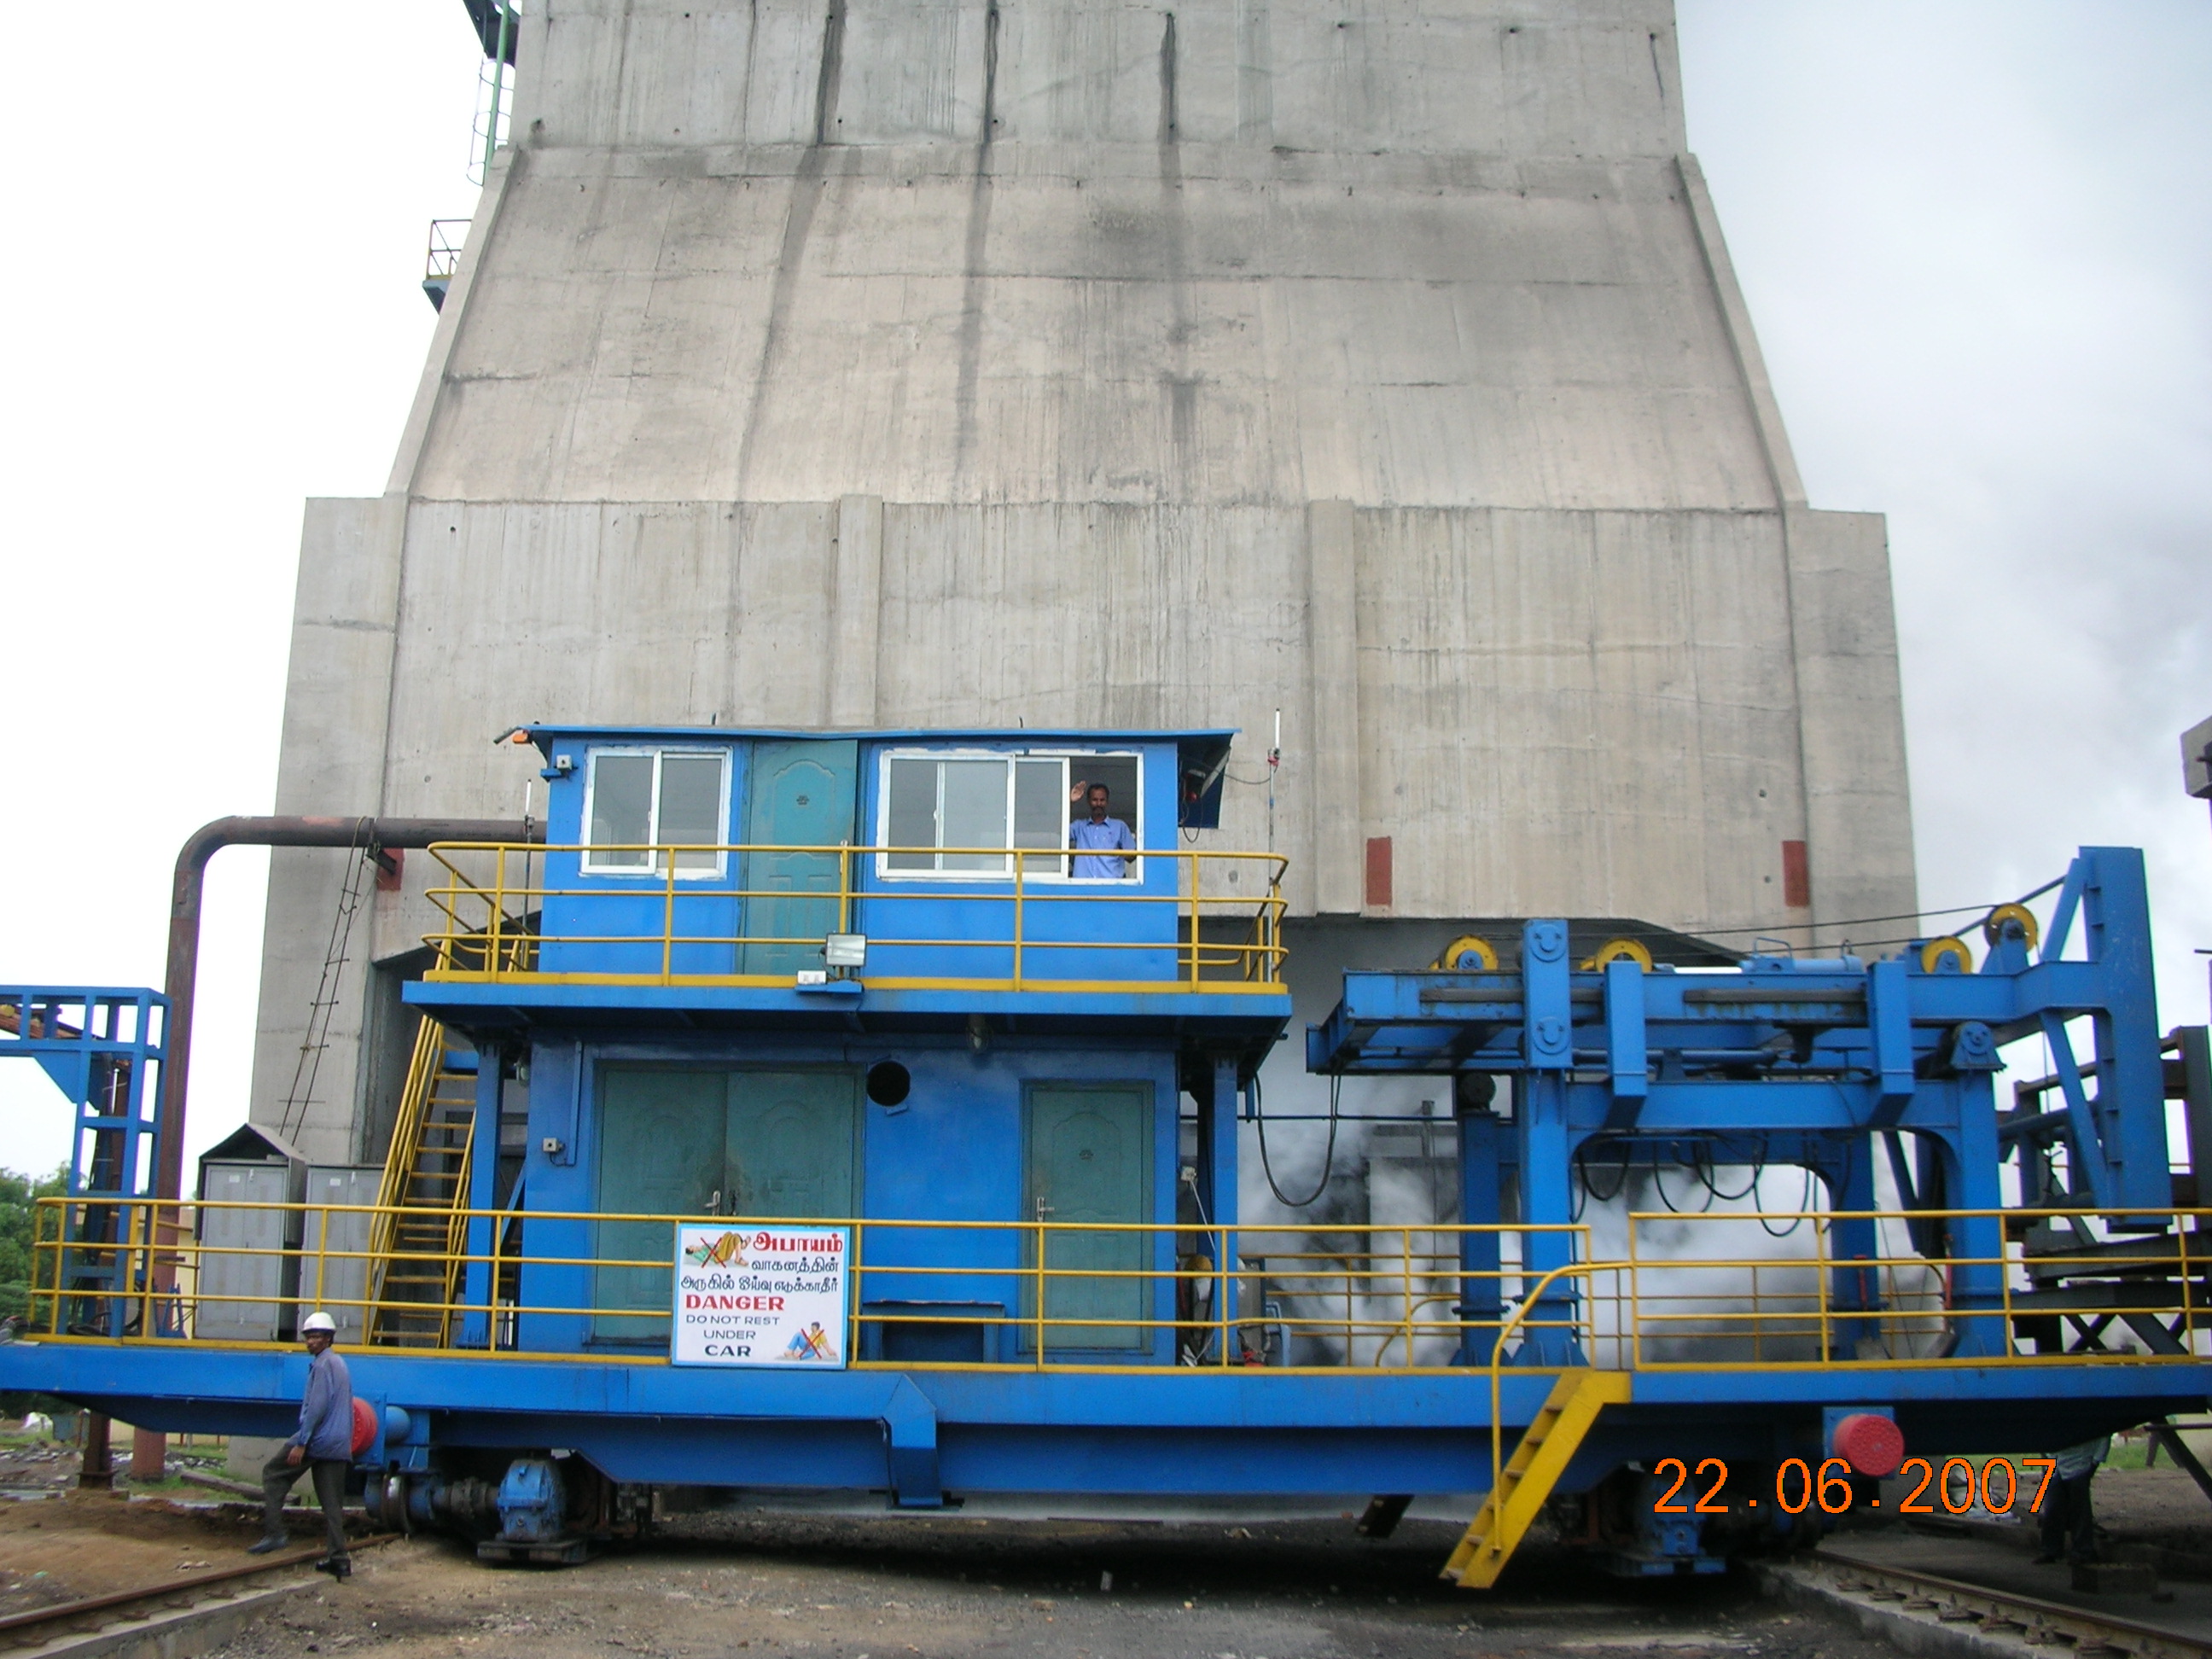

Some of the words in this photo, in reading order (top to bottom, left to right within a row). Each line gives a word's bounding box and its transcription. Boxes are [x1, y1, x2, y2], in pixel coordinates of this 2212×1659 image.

[753, 1231, 842, 1253] அபாயம்
[751, 1256, 839, 1273] வாகனத்தின்
[681, 1273, 735, 1291] அருகில்
[685, 1295, 784, 1311] DANGER
[686, 1315, 707, 1324] DO
[710, 1315, 741, 1324] NOT
[744, 1316, 779, 1325] REST
[703, 1330, 755, 1340] UNDER
[705, 1345, 751, 1357] CAR
